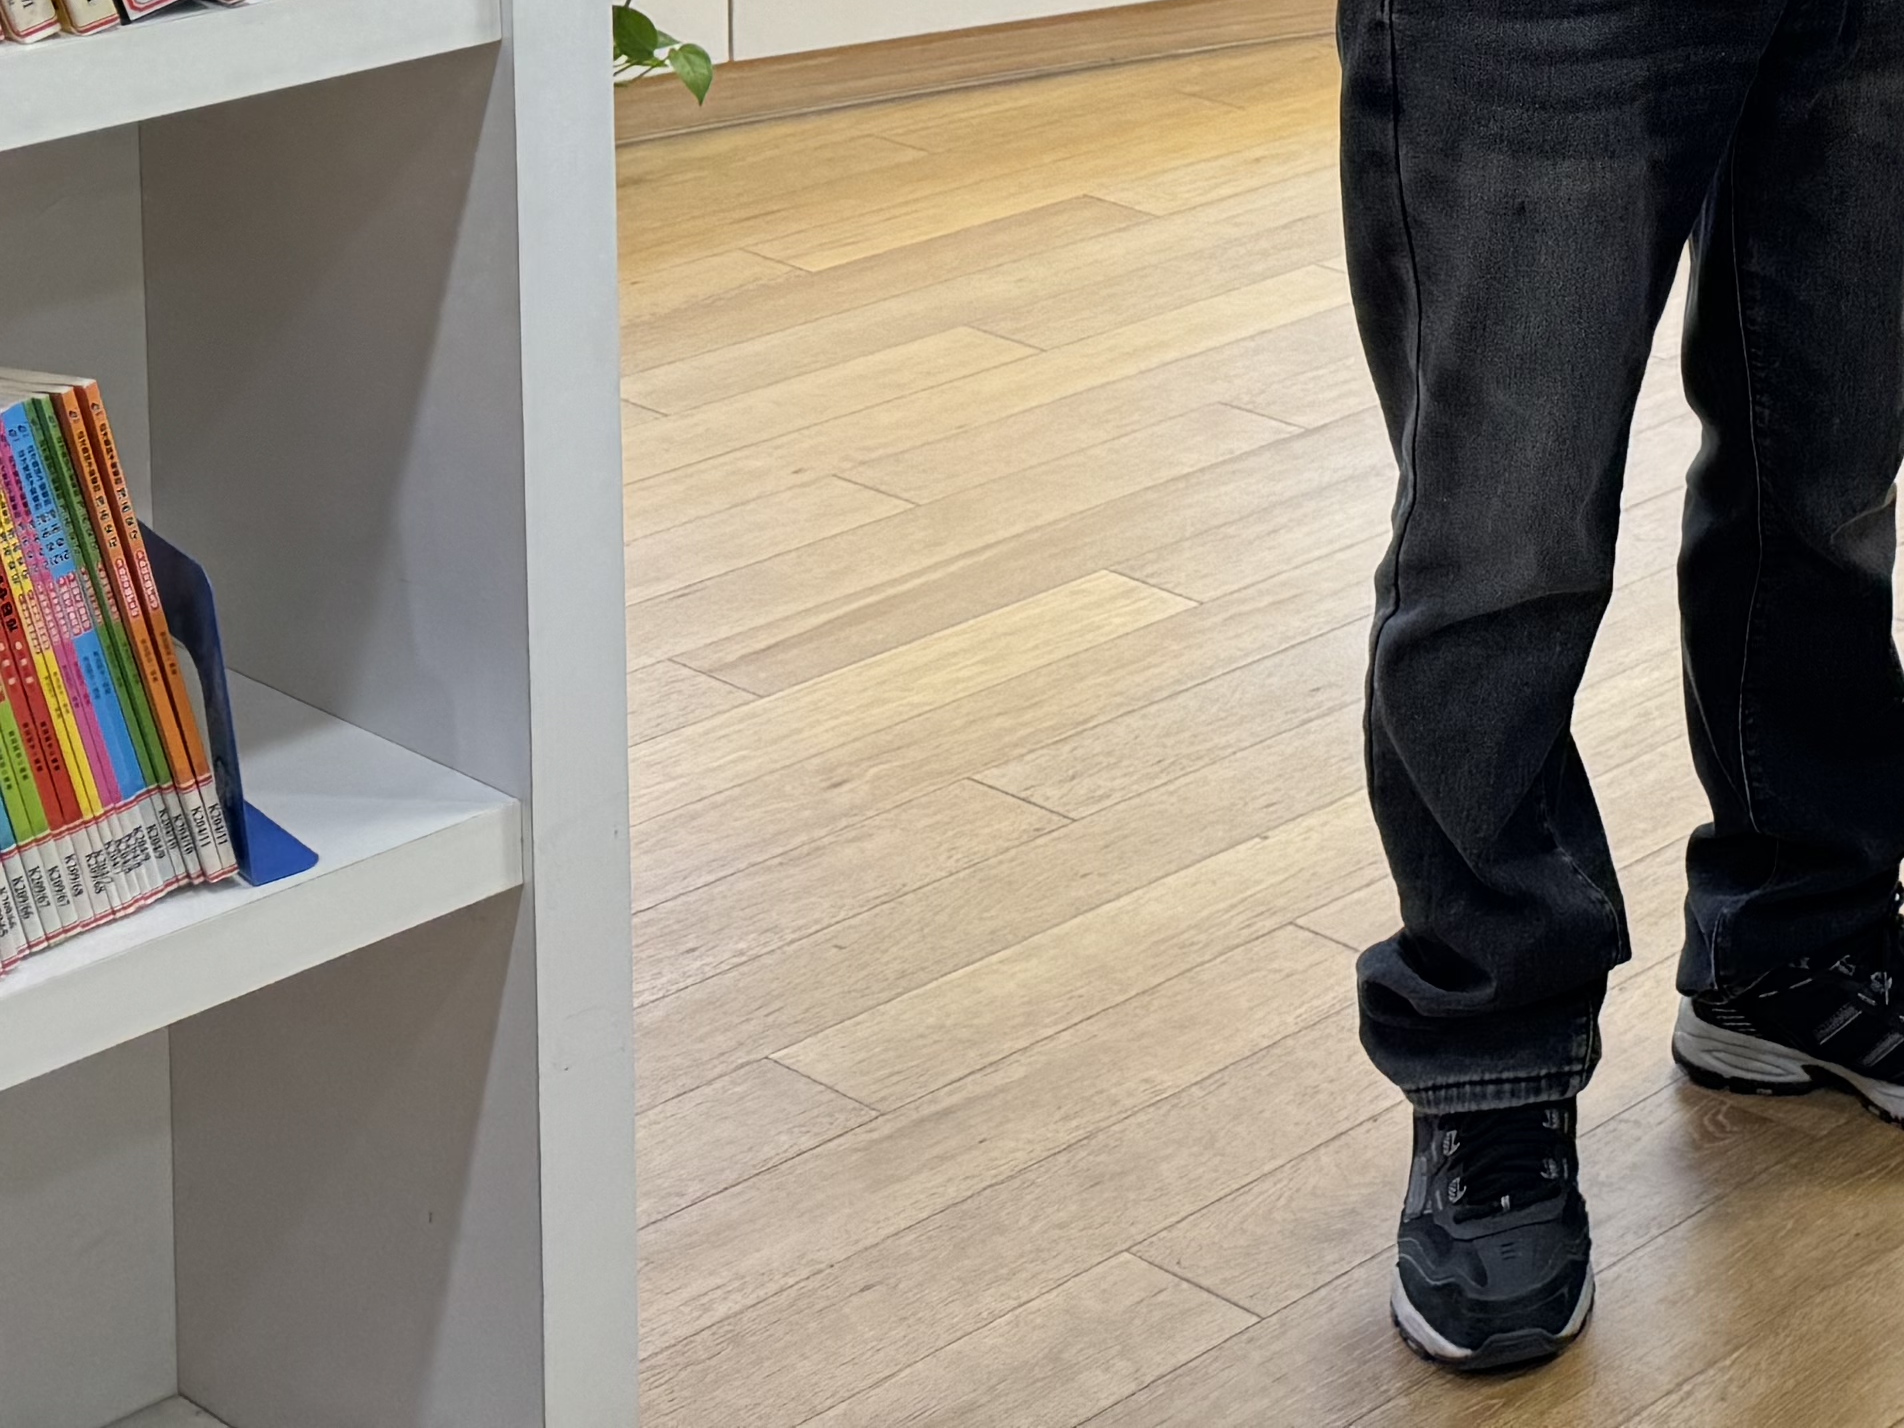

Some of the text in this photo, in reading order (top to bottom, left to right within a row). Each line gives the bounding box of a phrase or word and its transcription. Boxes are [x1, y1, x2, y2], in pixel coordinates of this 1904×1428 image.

[191, 807, 212, 847] K204/11
[207, 803, 229, 845] K204/11
[29, 866, 51, 908] K209/67
[48, 866, 70, 907] K209/67
